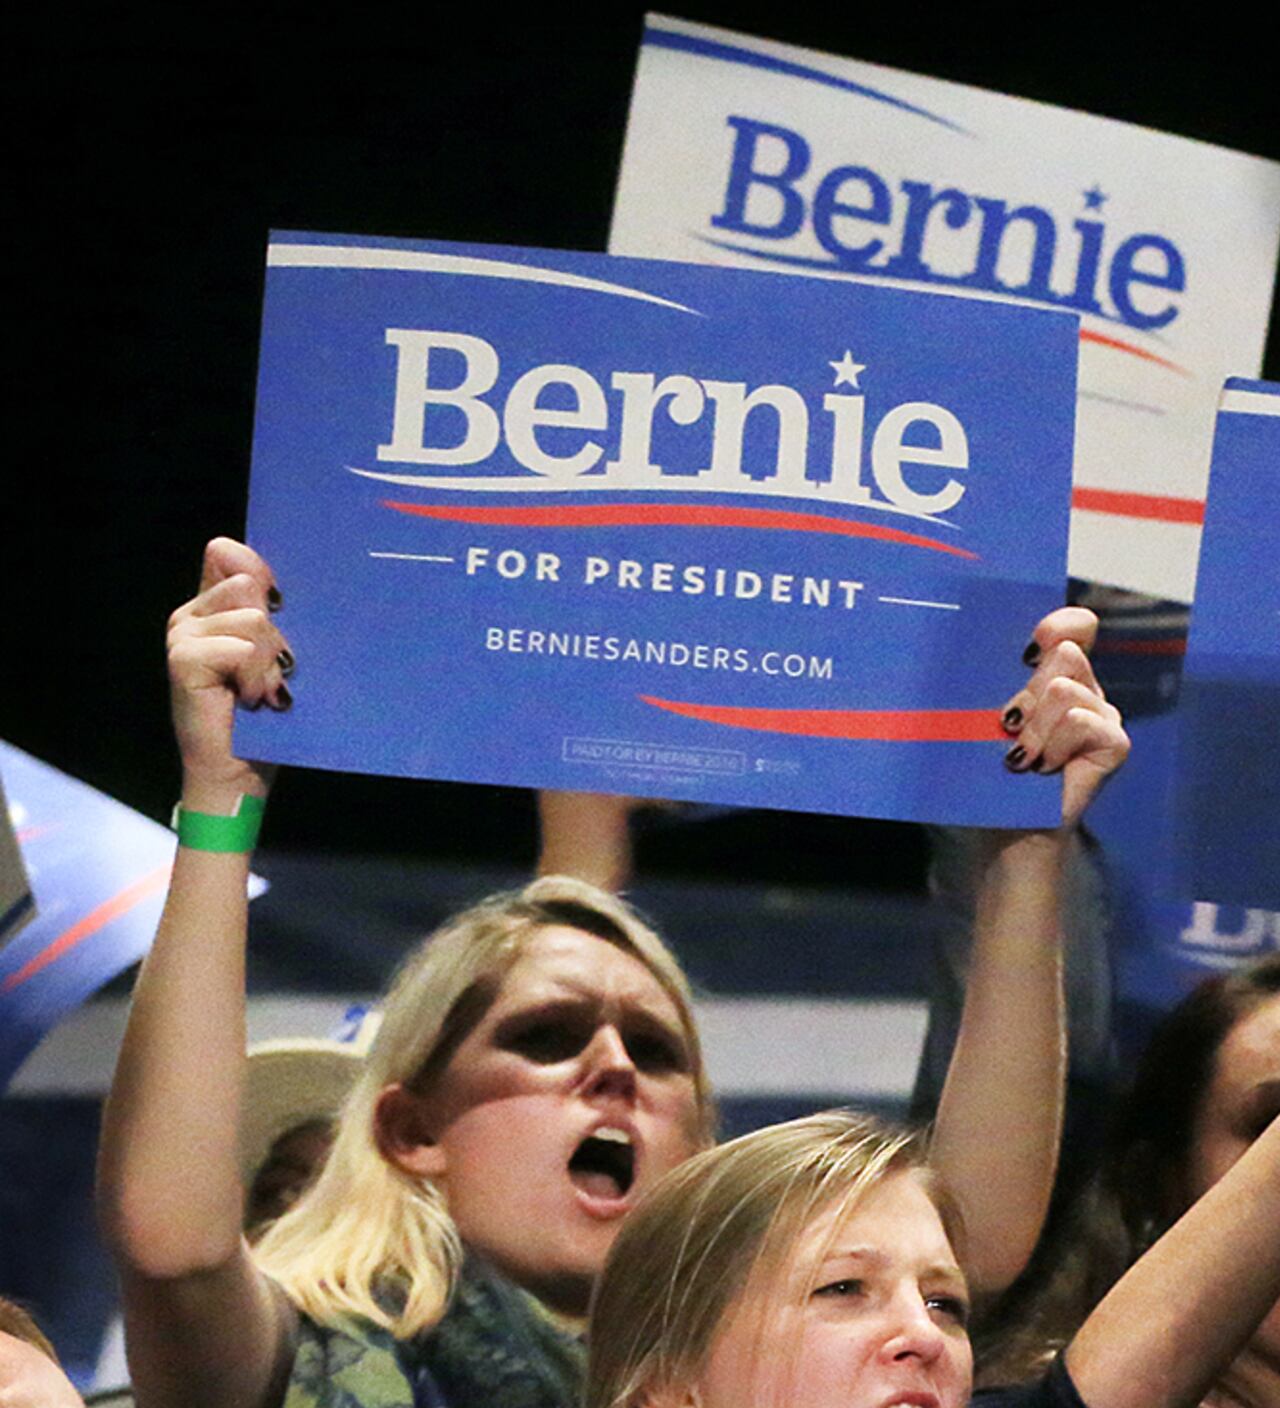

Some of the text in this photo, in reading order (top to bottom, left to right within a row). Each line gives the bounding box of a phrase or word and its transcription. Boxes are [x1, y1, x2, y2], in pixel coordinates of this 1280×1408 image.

[708, 115, 1188, 331] Bernie
[376, 326, 971, 518] Bernie
[465, 547, 866, 611] FOR PRESIDENT
[485, 628, 835, 682] BERNIESANDERS.COM
